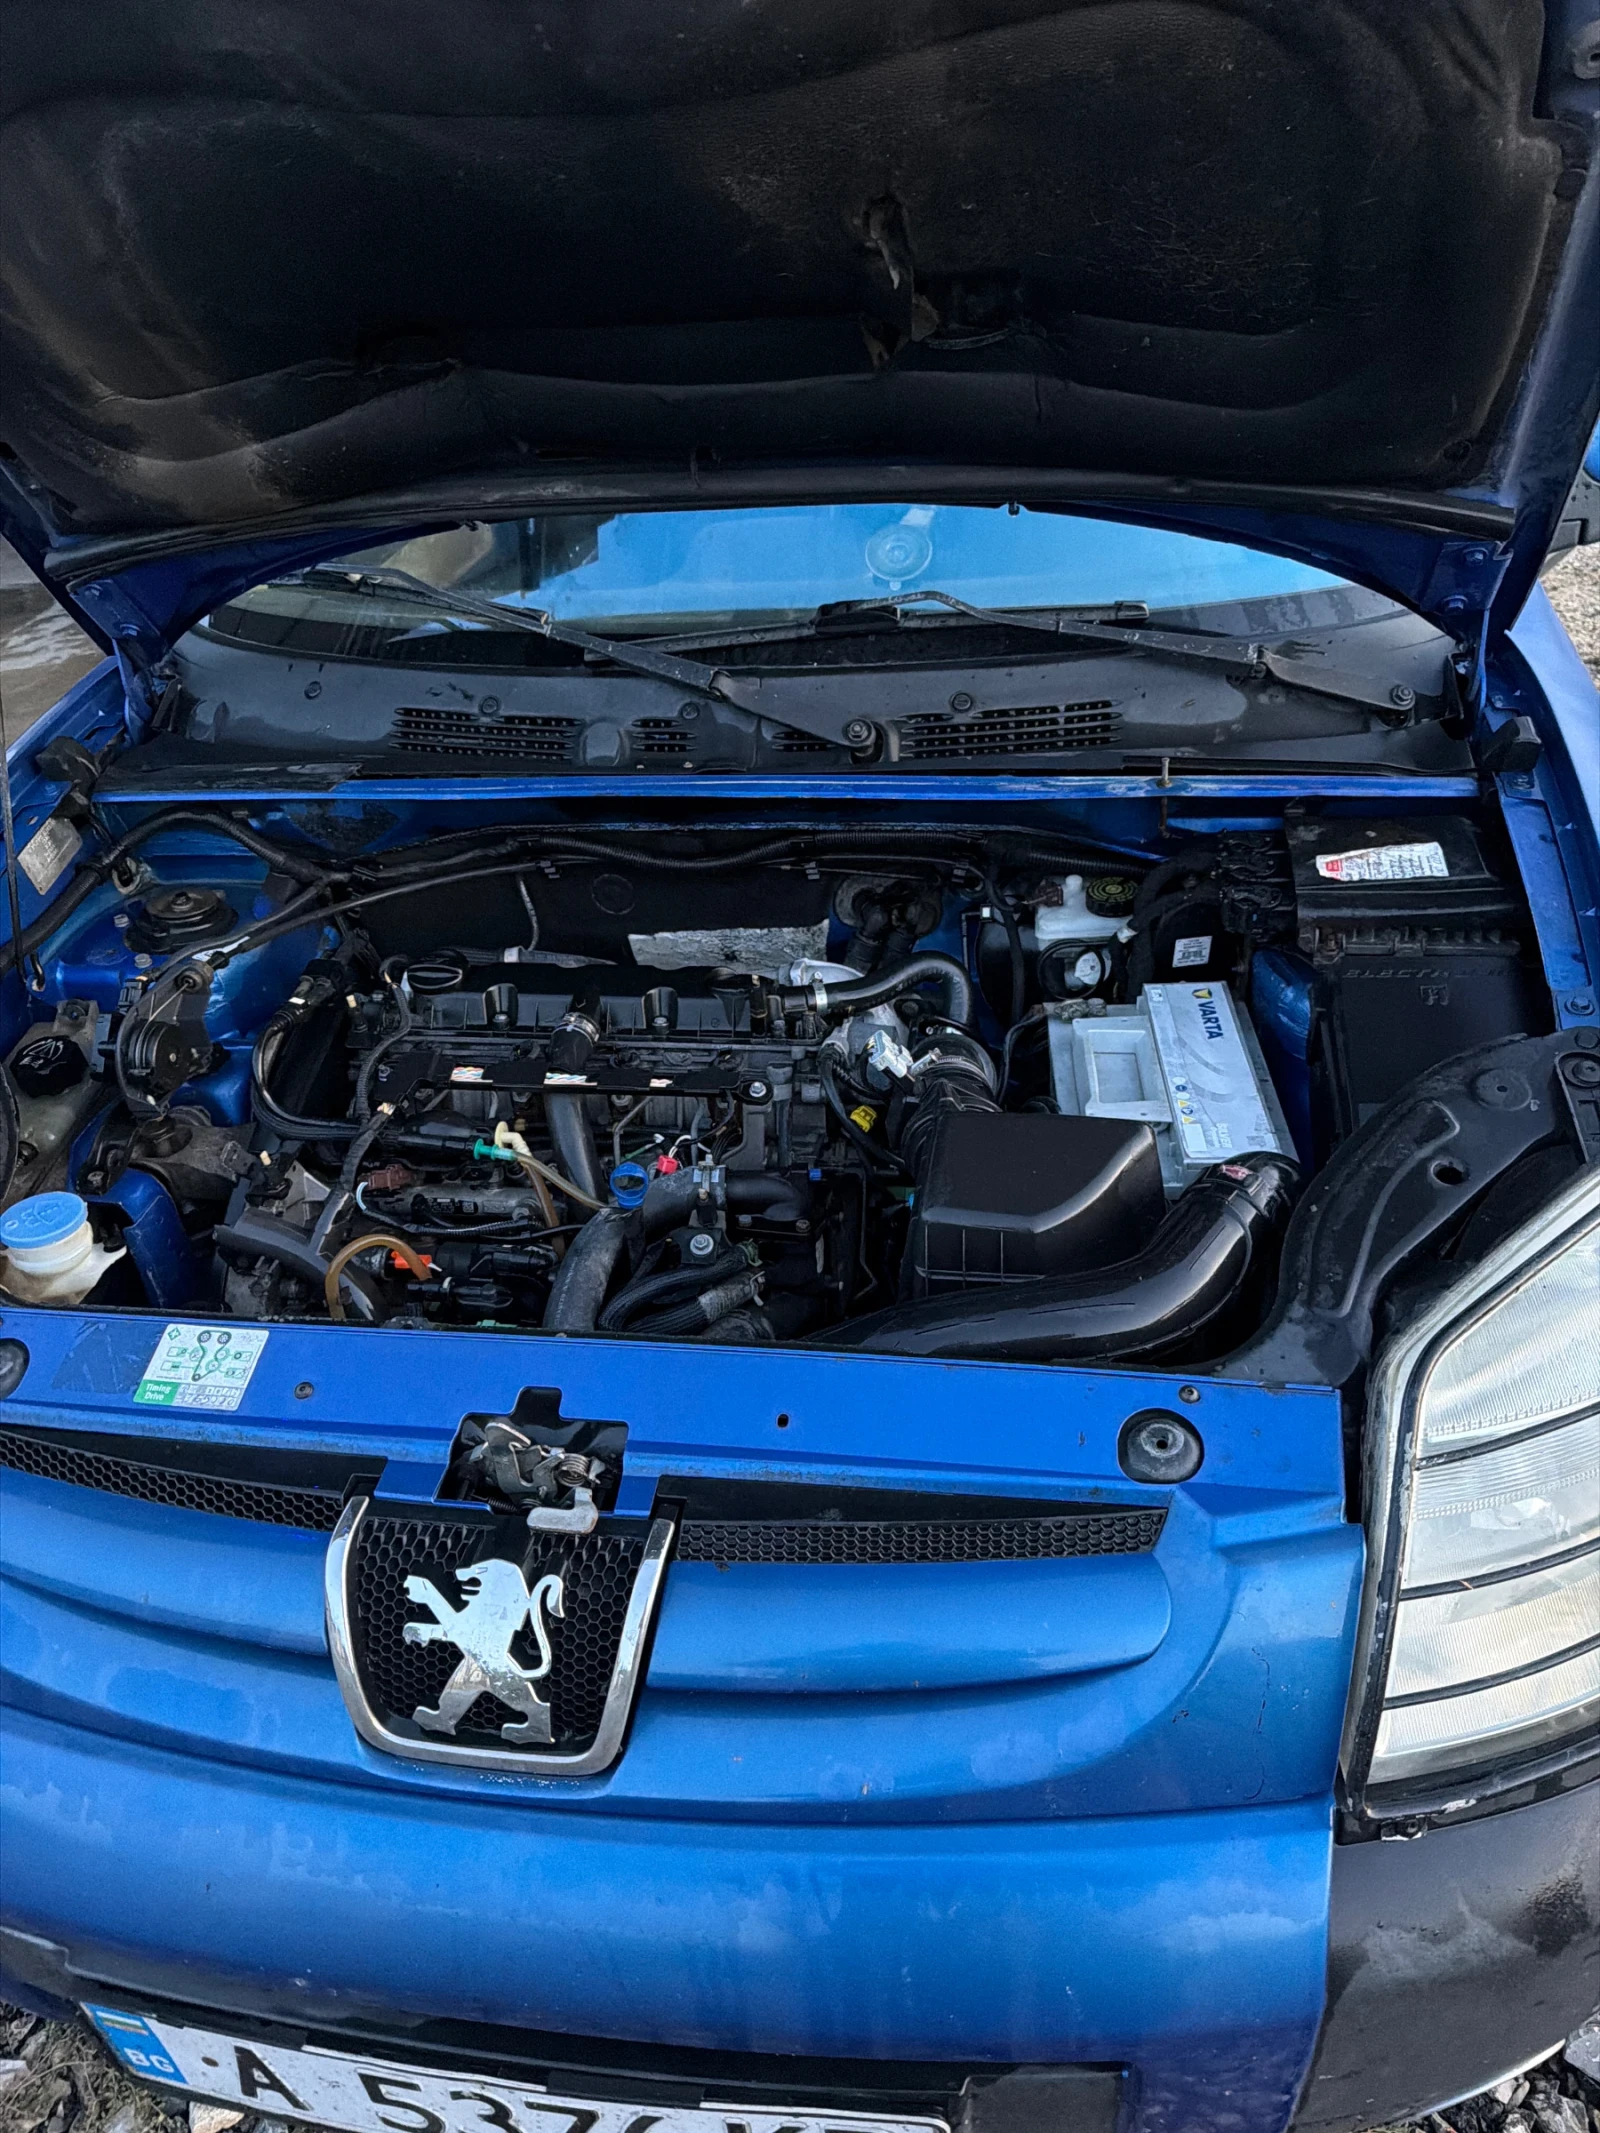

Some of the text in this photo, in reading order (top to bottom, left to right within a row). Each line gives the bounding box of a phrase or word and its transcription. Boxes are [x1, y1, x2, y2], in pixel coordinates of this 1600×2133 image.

[1198, 1001, 1224, 1040] VARTA
[144, 1391, 165, 1401] Drive
[145, 1383, 172, 1394] Timing
[123, 2047, 175, 2074] BG
[233, 2045, 313, 2111] A
